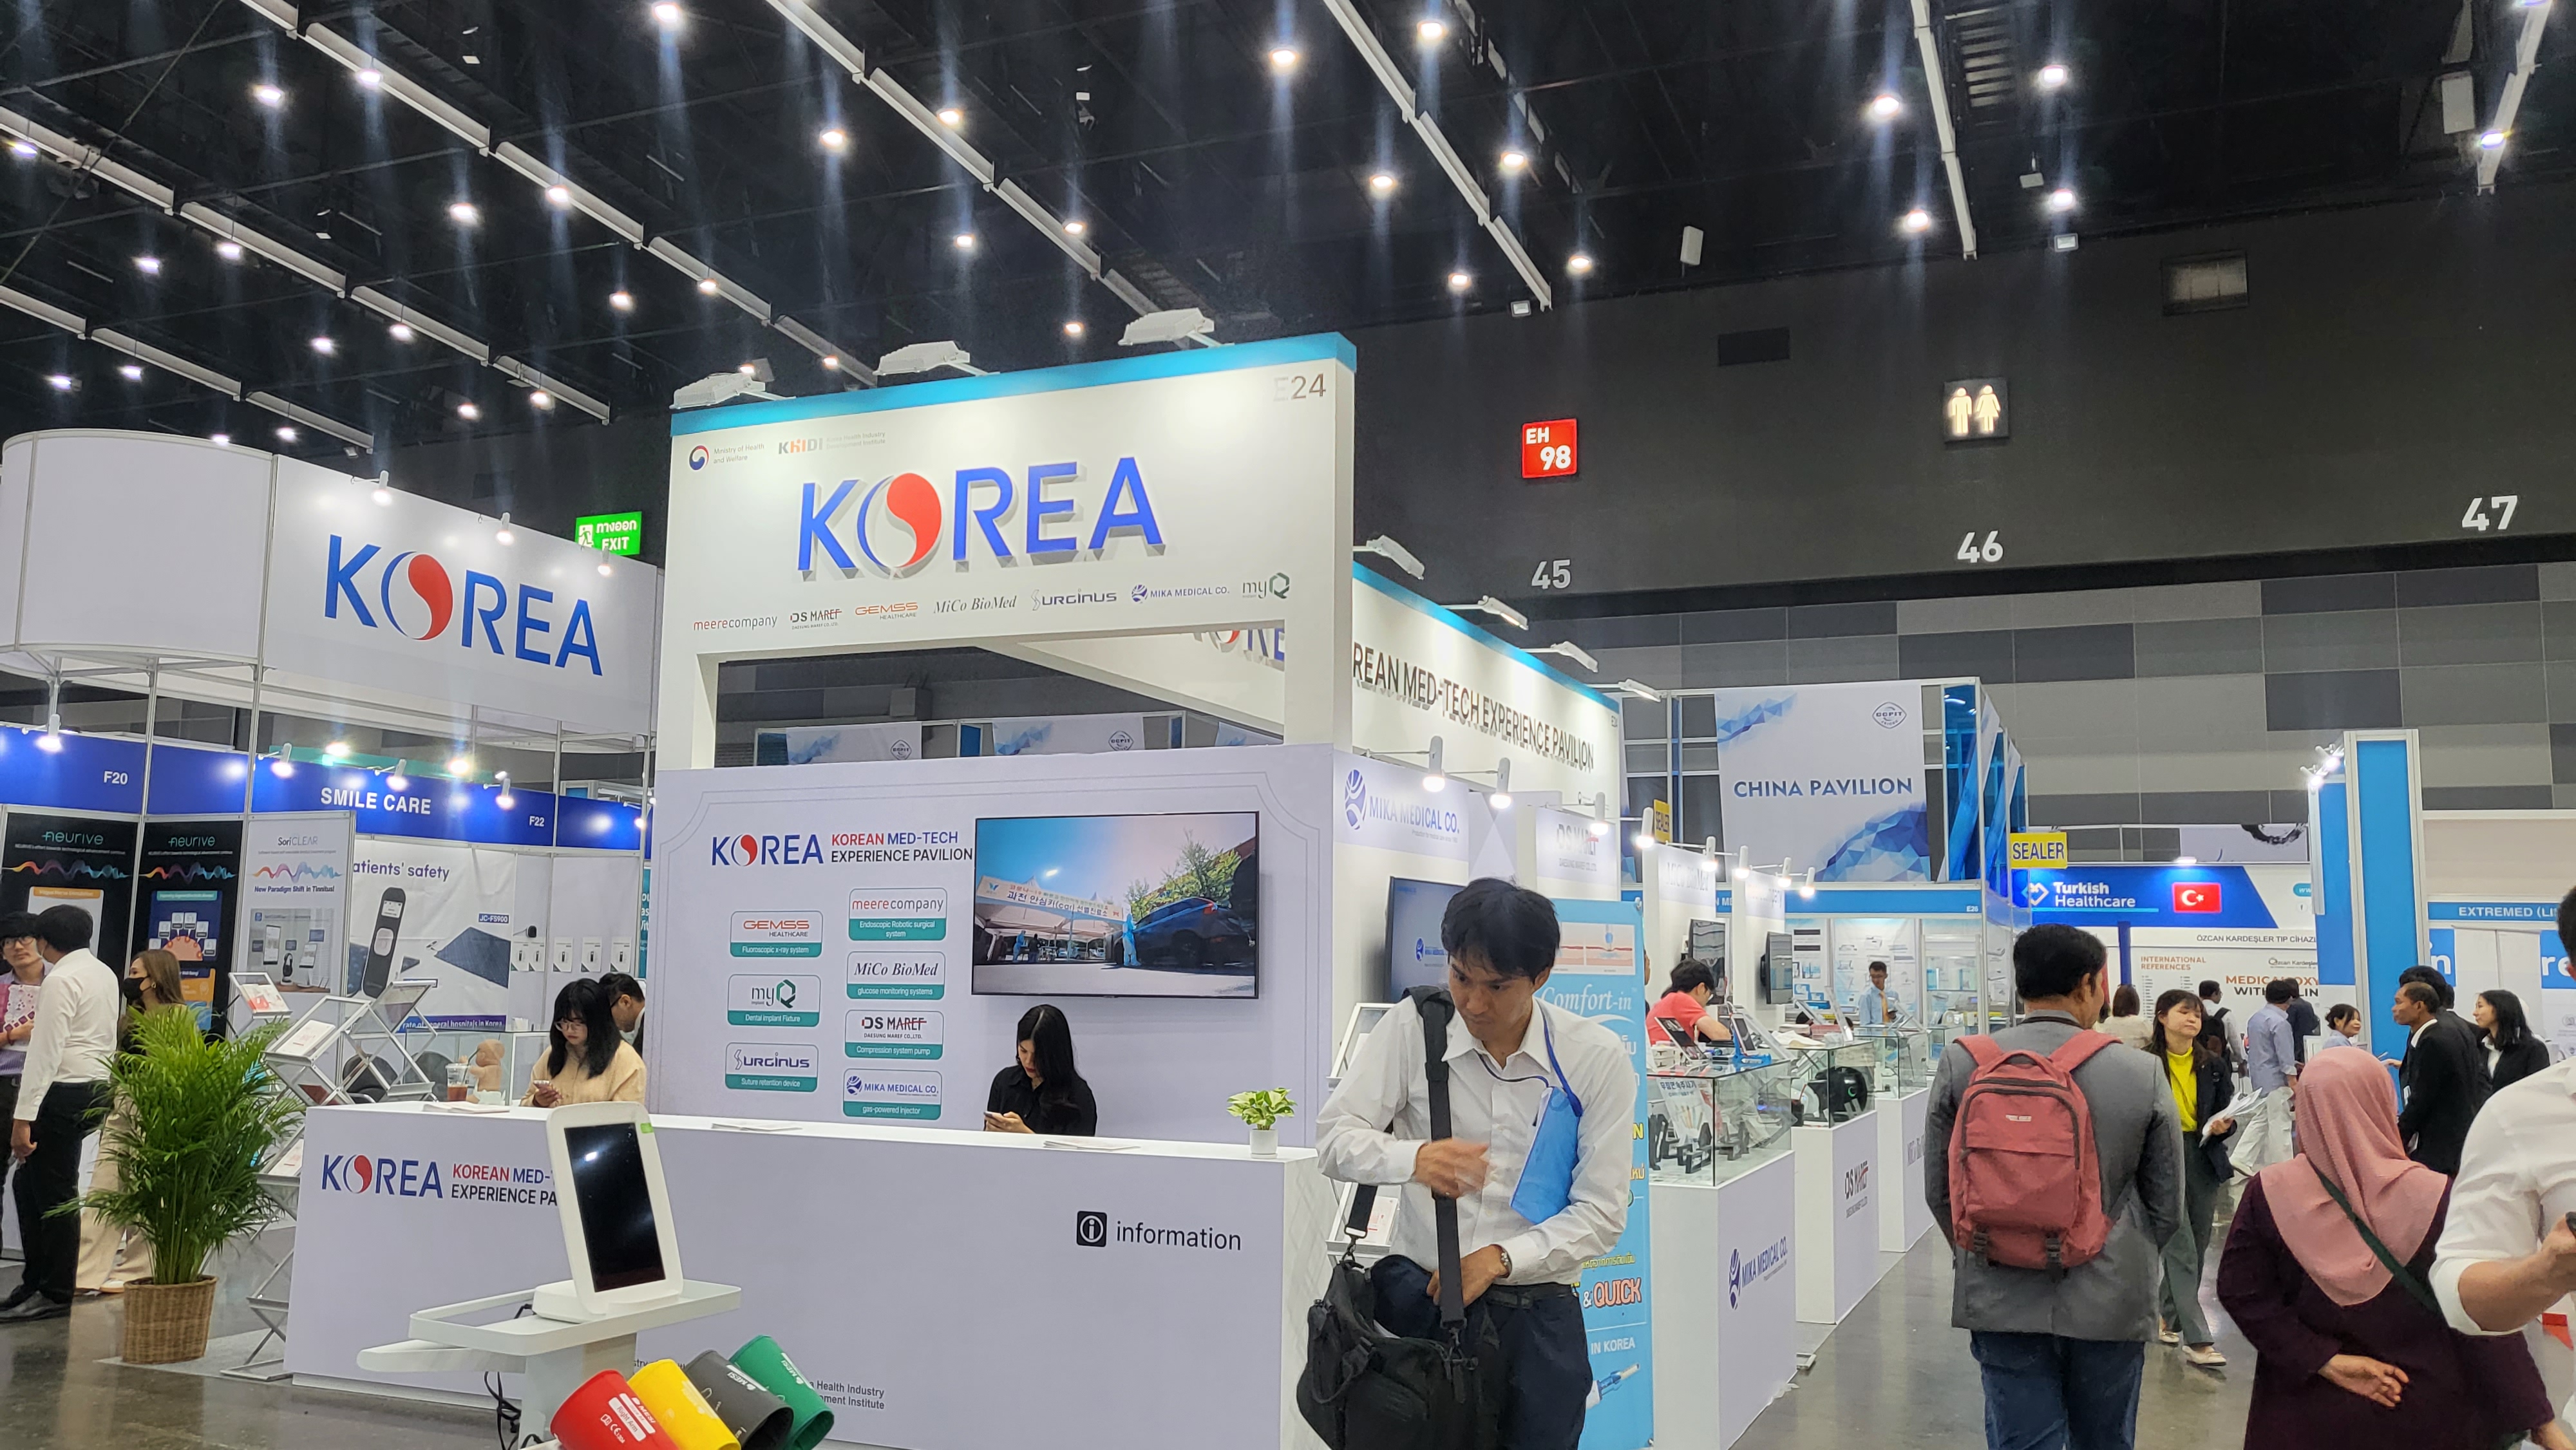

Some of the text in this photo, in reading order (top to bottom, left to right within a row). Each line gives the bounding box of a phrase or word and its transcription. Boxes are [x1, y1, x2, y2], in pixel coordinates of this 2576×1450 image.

[1526, 428, 1549, 444] EH
[745, 443, 764, 451] Health
[1540, 444, 1571, 471] 98
[797, 457, 1164, 572] KOREA
[2461, 494, 2518, 531] 47
[596, 519, 638, 534] ทางออก
[1956, 531, 2004, 563] 46
[1531, 558, 1572, 589] 45
[1150, 589, 1173, 598] MIKA
[1174, 587, 1214, 597] MEDICAL
[324, 535, 603, 676] KOREA
[855, 602, 918, 616] GEMSS
[933, 595, 1018, 614] MiCo BioMed
[693, 614, 778, 632] meerecompany
[1403, 661, 1481, 725] MED-TECH
[1482, 695, 1549, 753] EXPERIENCE
[1553, 728, 1595, 769] PAVILION
[103, 770, 128, 786] F20
[1734, 777, 1913, 798] CHINA PAVILION
[320, 787, 432, 815] SMILE CARE
[529, 815, 545, 828] F22
[1369, 796, 1460, 834] MIKA MEDICAL CO.
[831, 831, 959, 846] KOREAN MED-TECH
[711, 834, 824, 866] KOREA
[831, 847, 973, 863] EXPERIENCE PAVILION
[2012, 841, 2065, 861] SEALER
[407, 864, 450, 882] safety
[1007, 890, 1027, 902] 과천
[2053, 881, 2109, 895] Turkish
[852, 898, 944, 912] meerecompany
[2054, 894, 2136, 908] Healthcare
[2458, 907, 2533, 917] EXTREMED
[743, 920, 810, 930] GEMSS
[859, 921, 891, 929] Endoscopic
[913, 921, 935, 929] surgical
[886, 930, 906, 939] system
[2226, 935, 2274, 944] KARDEŞLER
[742, 946, 775, 954] Fluoroscopic
[853, 962, 939, 976] MiCo BioMed
[857, 987, 879, 995] glucose
[880, 987, 909, 996] monitoring
[1541, 983, 1633, 1015] Comfort-in
[861, 1017, 927, 1031] DS MAREF
[857, 1046, 931, 1057] Compression system pump
[741, 1078, 757, 1086] Suture
[758, 1078, 782, 1087] retention
[864, 1083, 939, 1094] MIKA MEDICAL CO.
[862, 1106, 900, 1115] gas-powered
[321, 1153, 444, 1199] KOREA
[452, 1163, 511, 1183] KOREAN
[451, 1184, 536, 1204] EXPERIENCE
[1116, 1220, 1242, 1251] information
[1593, 1277, 1642, 1308] QUICK
[1591, 1336, 1636, 1356] IN KOREA
[817, 1379, 846, 1393] Health
[847, 1382, 885, 1398] Industry
[848, 1397, 885, 1410] Institute
